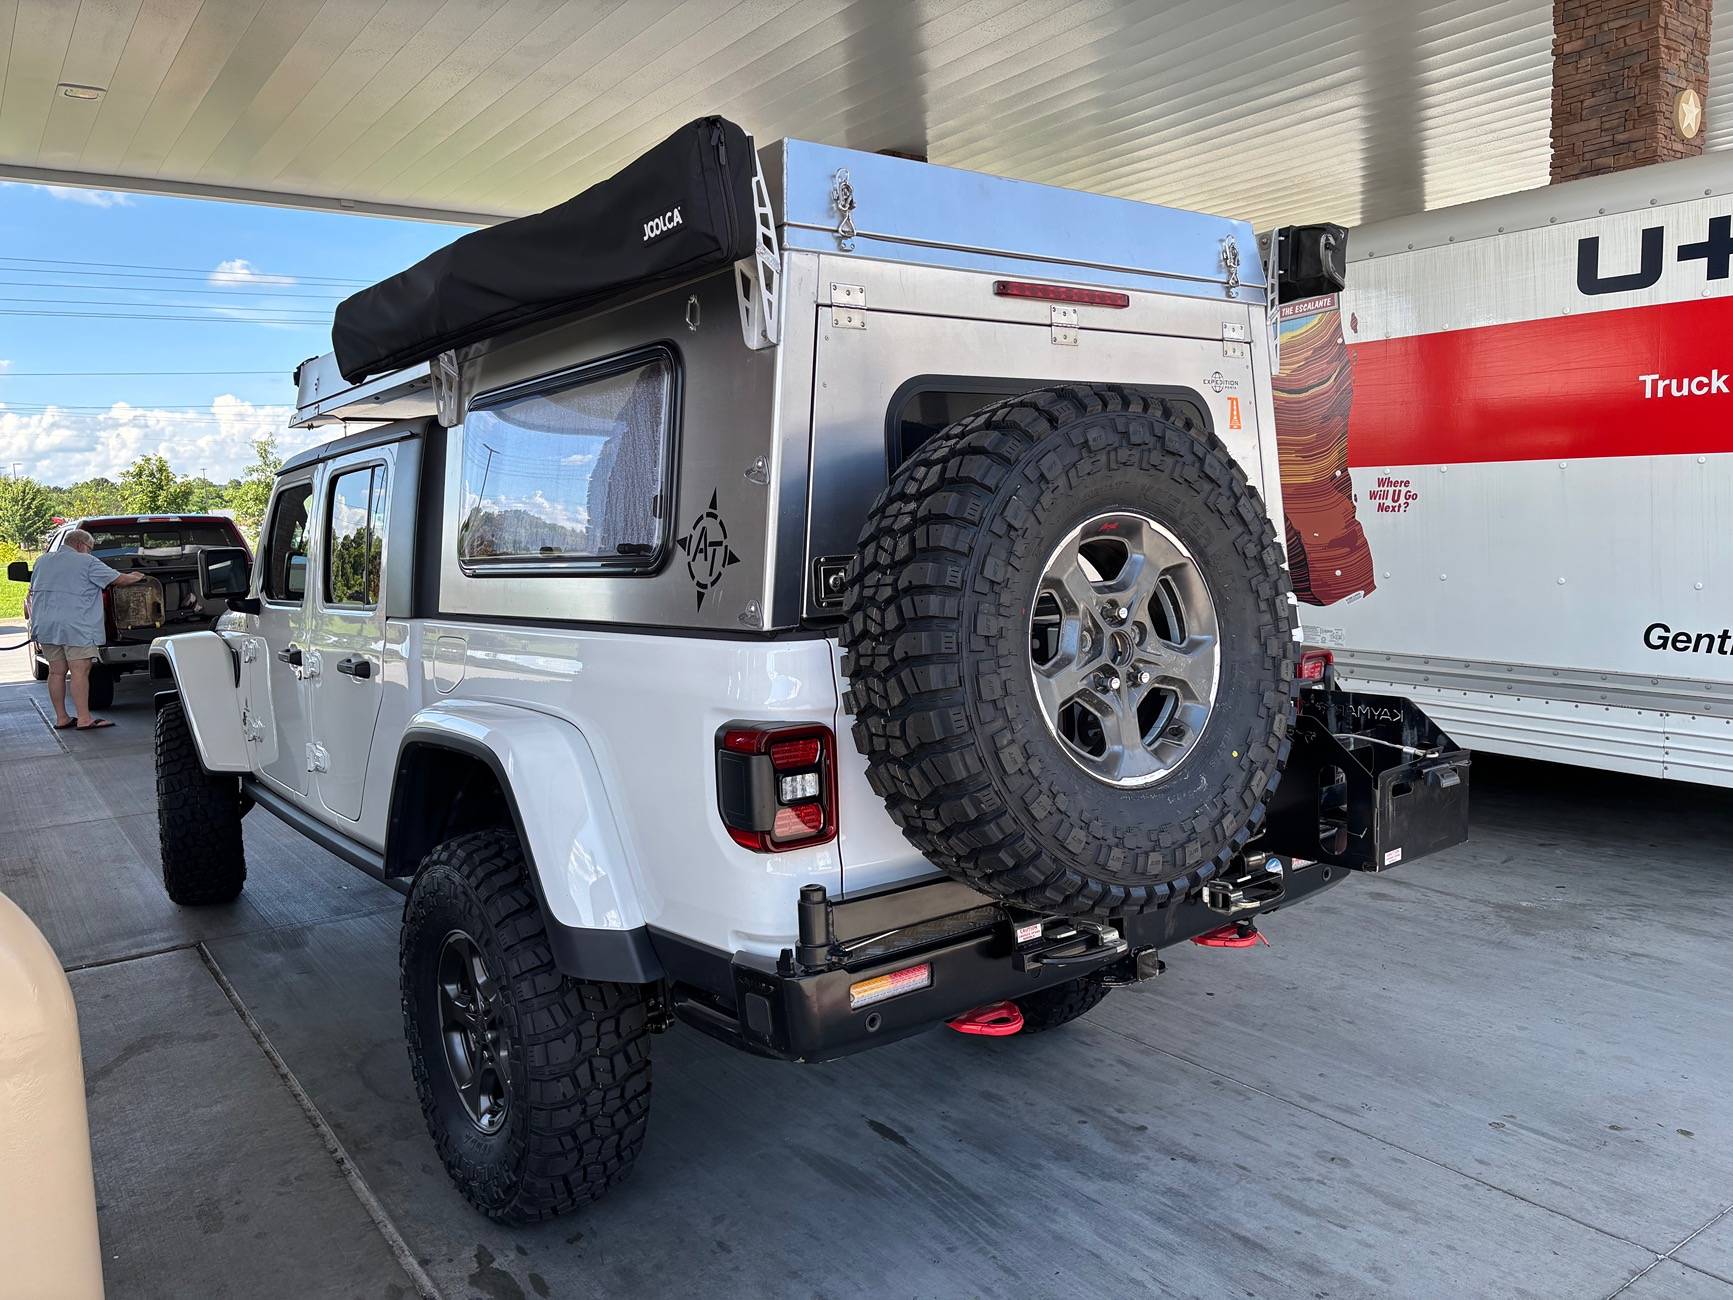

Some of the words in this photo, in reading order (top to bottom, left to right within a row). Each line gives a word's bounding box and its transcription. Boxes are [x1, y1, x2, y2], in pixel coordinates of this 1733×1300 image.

[643, 207, 683, 241] JOOLCA
[1281, 305, 1294, 317] THE
[1295, 297, 1332, 314] ESCALANTE
[1638, 368, 1730, 399] Truck
[1377, 477, 1410, 488] Where
[1369, 490, 1389, 500] Will
[1391, 489, 1402, 503] U
[1404, 490, 1418, 501] Go
[1377, 501, 1409, 512] Next?
[1643, 622, 1733, 656] Gent
